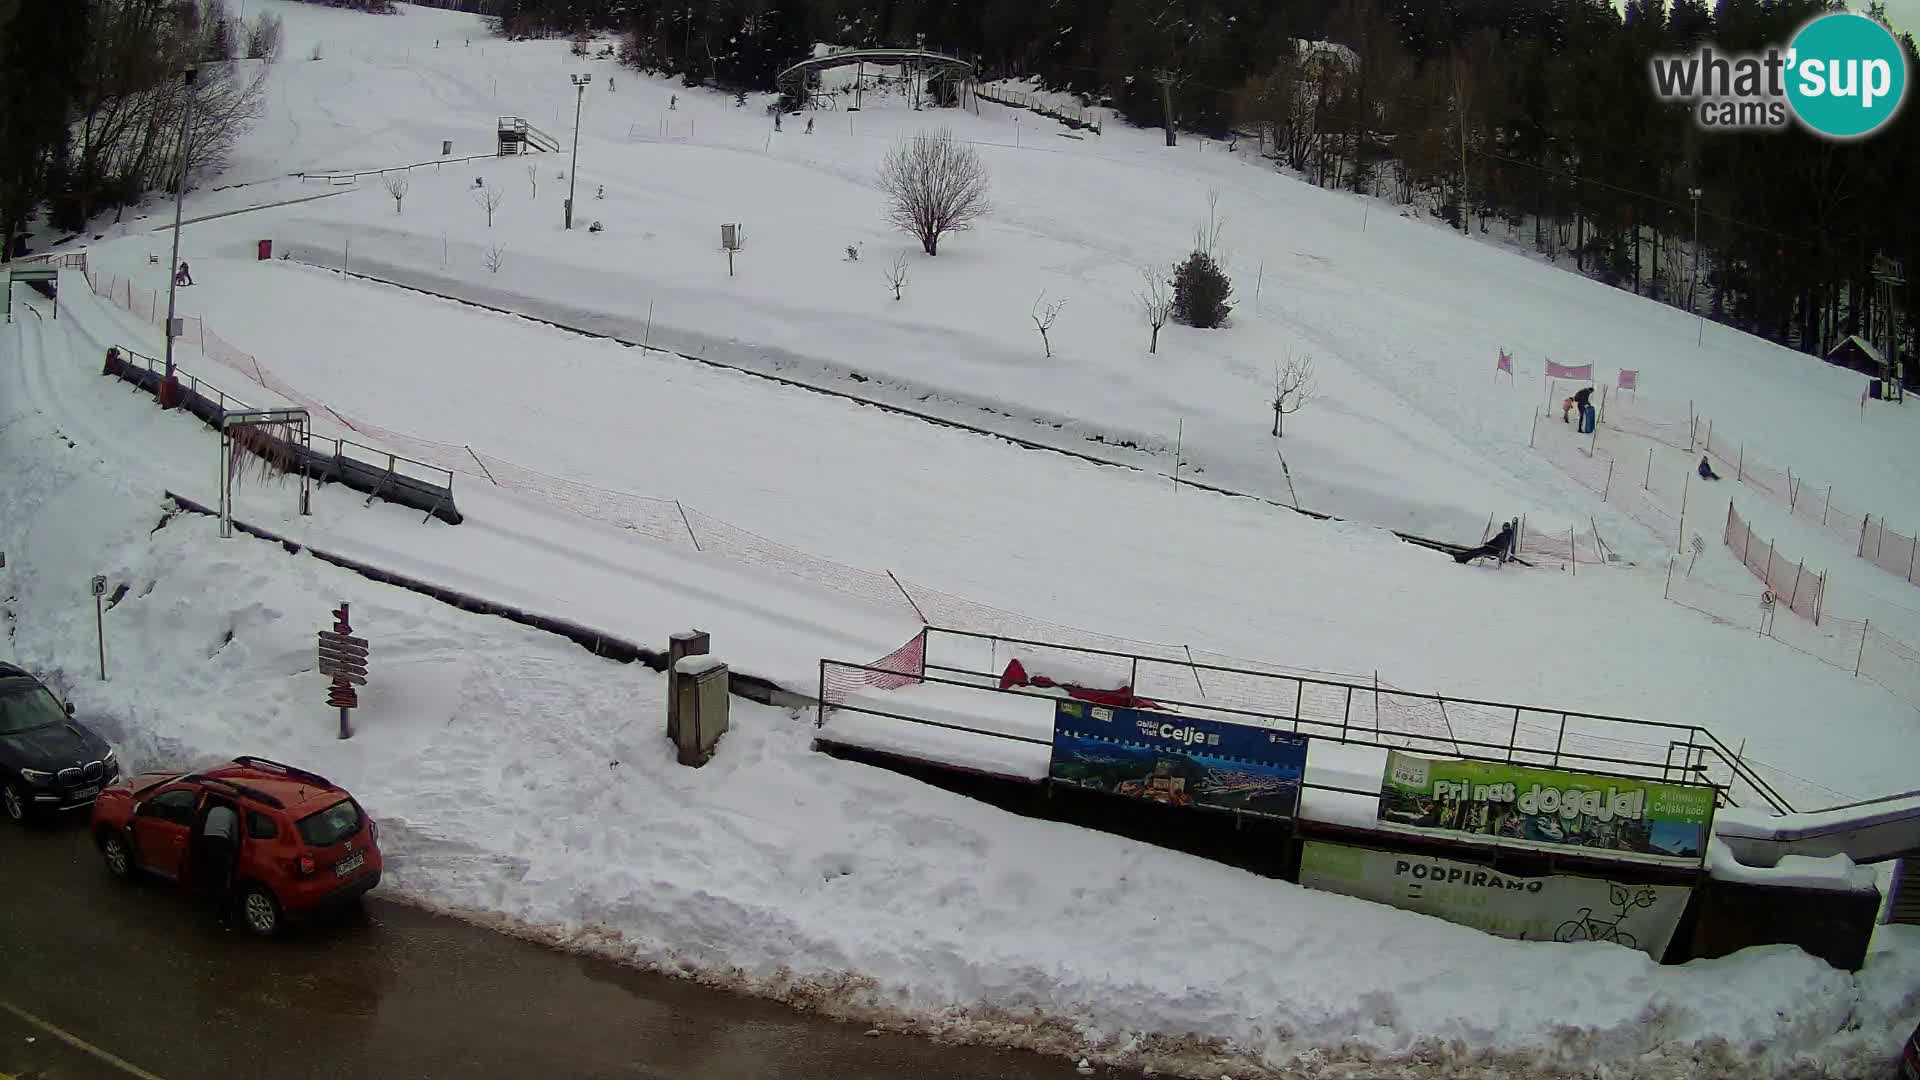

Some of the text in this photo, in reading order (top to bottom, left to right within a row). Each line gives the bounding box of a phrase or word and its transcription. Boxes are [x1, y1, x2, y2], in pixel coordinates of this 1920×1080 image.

[1141, 727, 1159, 737] Visit
[1160, 723, 1205, 746] Celje
[1433, 778, 1470, 801] Pri
[1473, 782, 1516, 803] nas
[1395, 860, 1543, 893] PODPIRAMO
